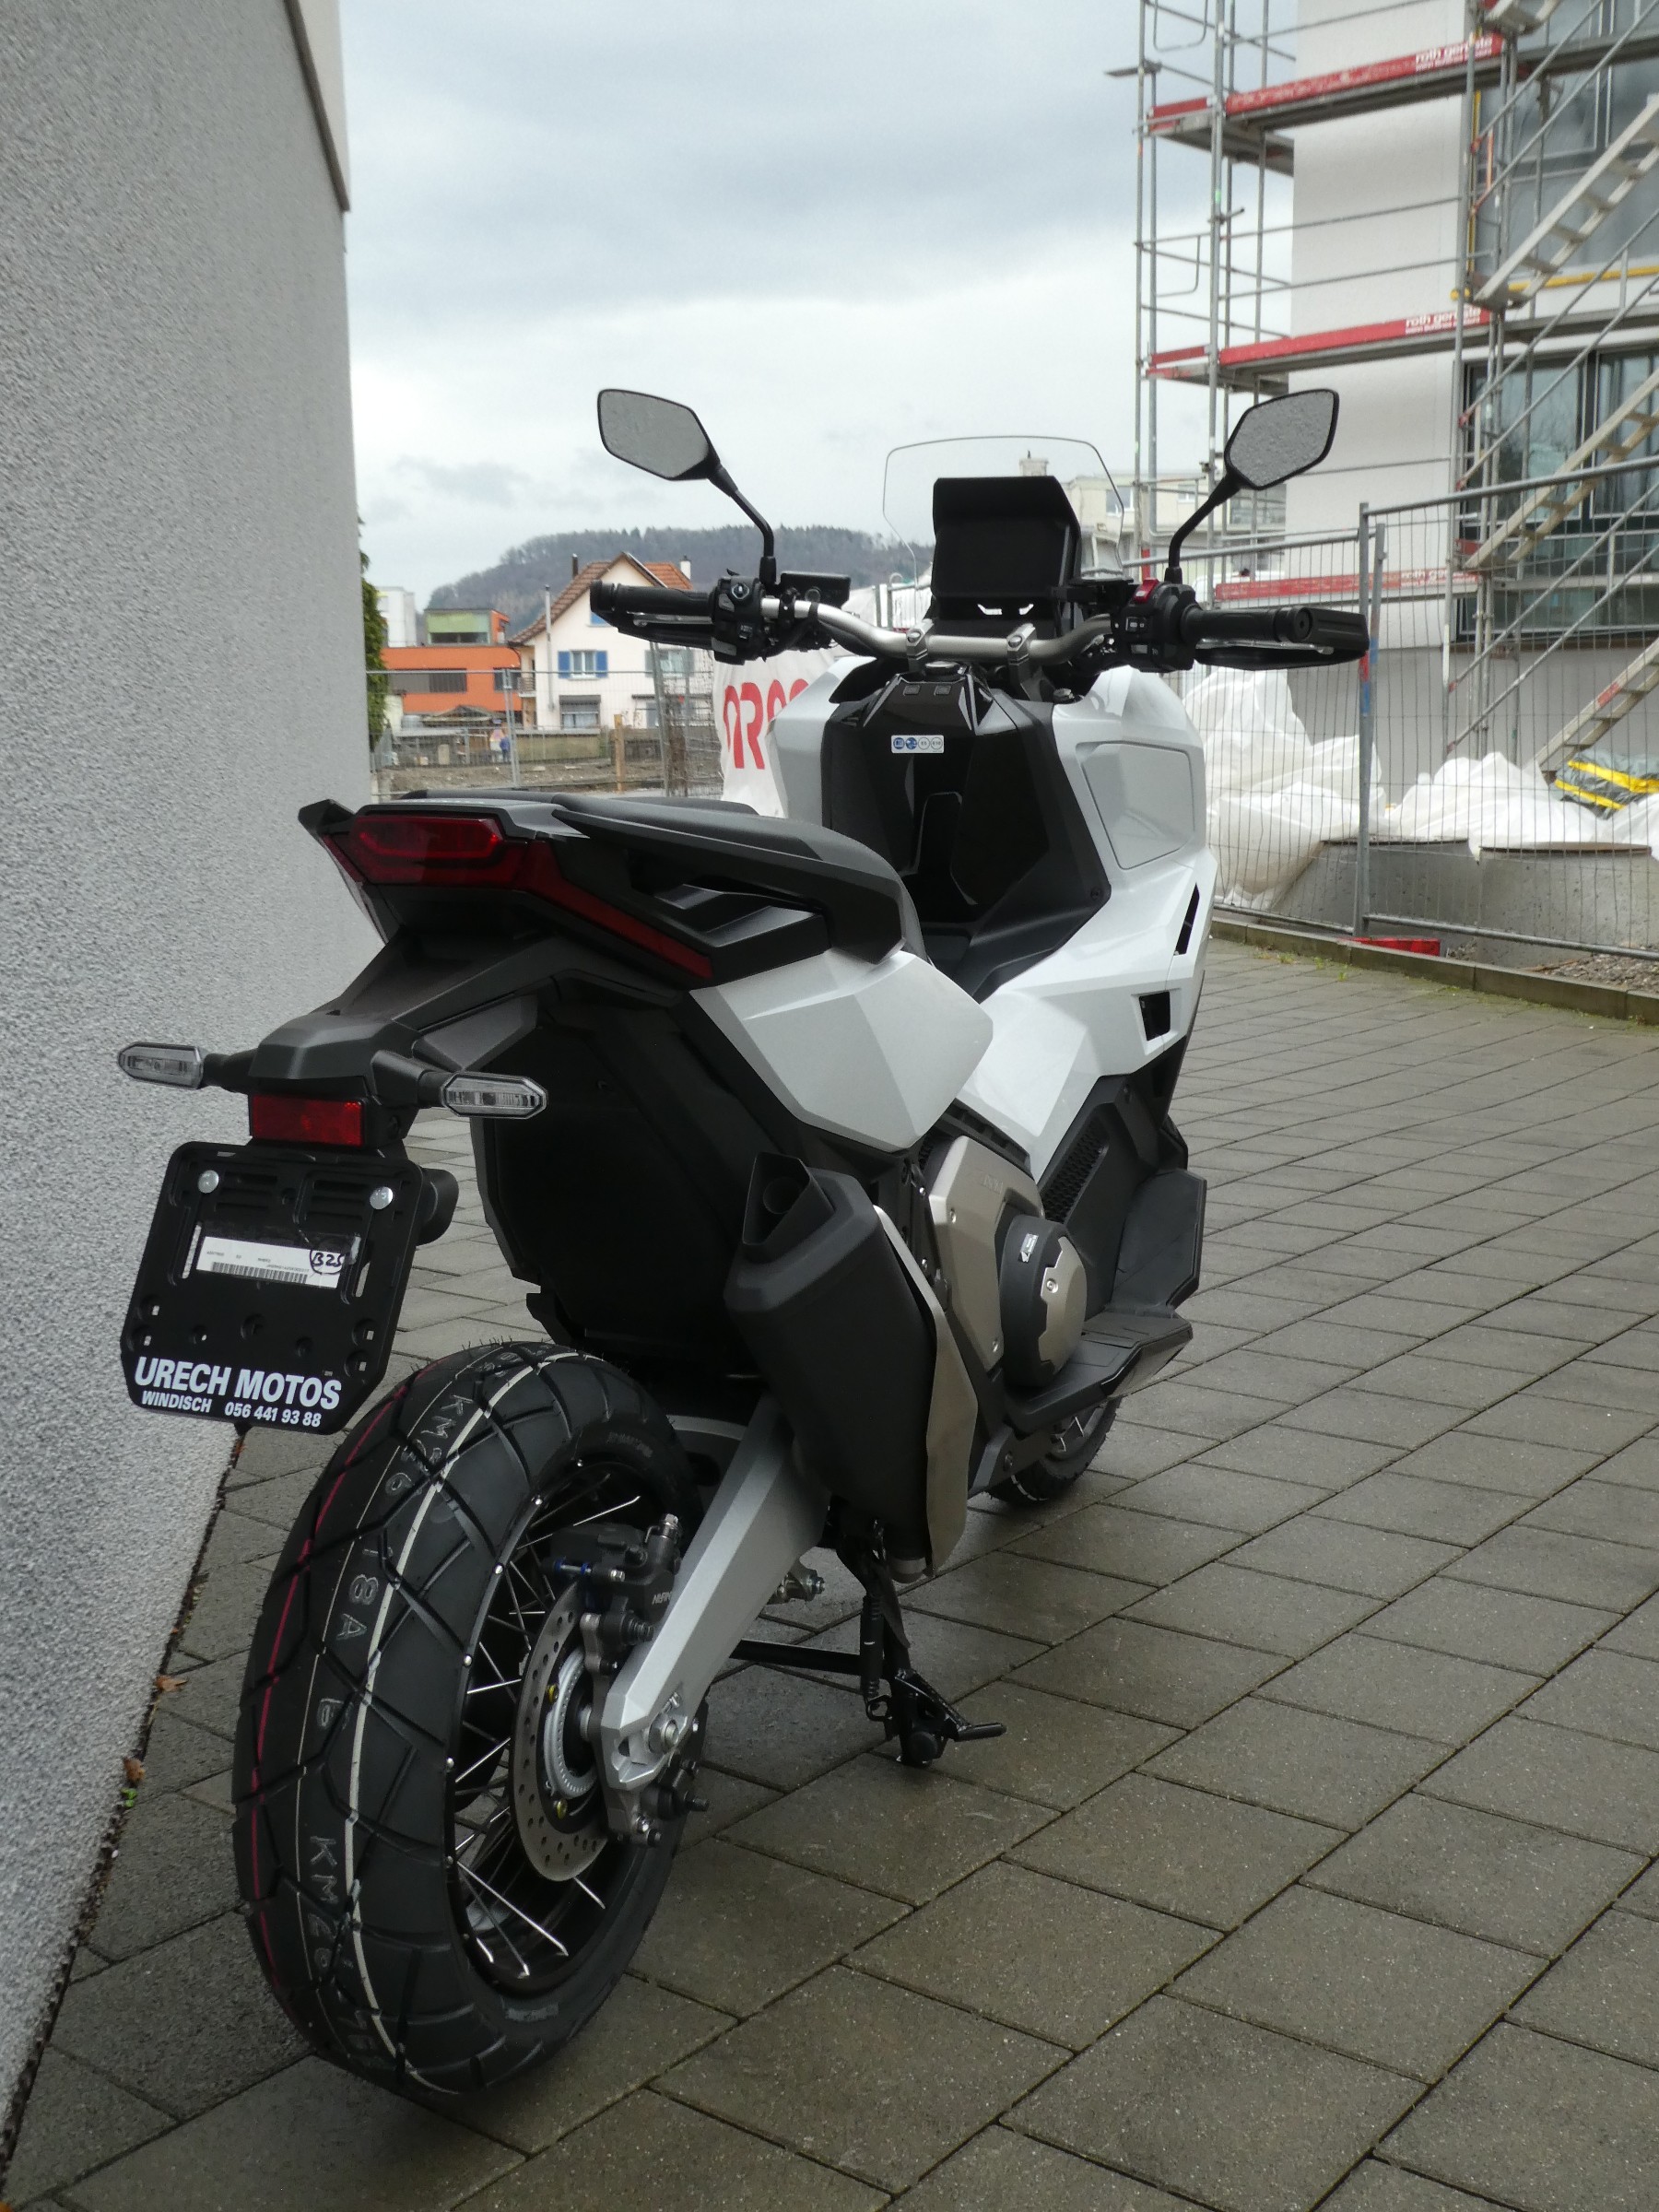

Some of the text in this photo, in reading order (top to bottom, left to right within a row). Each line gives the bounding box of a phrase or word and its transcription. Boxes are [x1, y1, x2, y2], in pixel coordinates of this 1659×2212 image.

[135, 1356, 342, 1410] URECH MOTOS
[142, 1390, 322, 1428] WINDISCH 056 441 93 88
